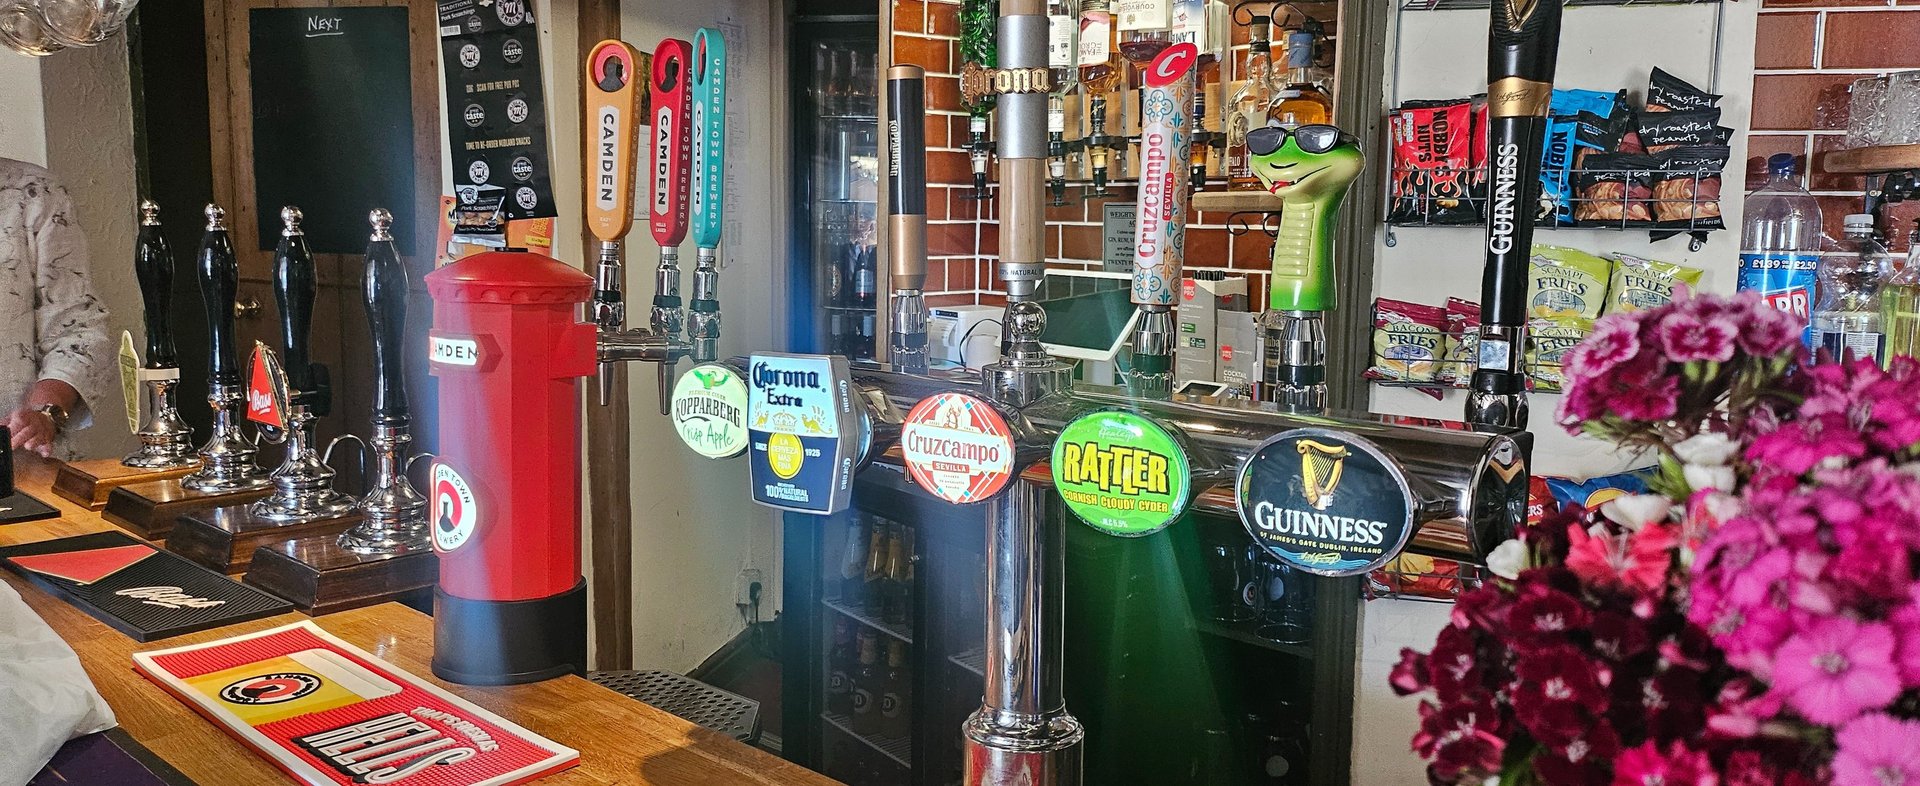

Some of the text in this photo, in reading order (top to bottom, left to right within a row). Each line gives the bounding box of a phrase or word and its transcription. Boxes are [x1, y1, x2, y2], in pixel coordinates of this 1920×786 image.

[308, 15, 342, 31] NEXT
[960, 61, 1051, 105] Corona
[1666, 92, 1712, 107] roasted
[466, 112, 484, 120] taste
[711, 121, 720, 157] TOWN
[1638, 122, 1712, 136] dry roasted
[1653, 134, 1700, 145] peanuts
[681, 127, 690, 161] TOWN
[1417, 124, 1432, 163] NUTS
[513, 165, 532, 173] taste
[601, 113, 615, 201] CAMDEN
[658, 114, 669, 205] CAMDEN
[679, 168, 687, 227] BREWERY
[709, 165, 718, 228] BREWERY
[1138, 133, 1166, 258] Cruzcampo
[1164, 177, 1173, 217] SEVILLA
[1489, 142, 1519, 256] GUINNESS
[1541, 267, 1583, 280] SCAMPI
[1629, 267, 1673, 283] SCAMPI
[1794, 261, 1817, 270] £2.50
[1537, 277, 1588, 296] FRIES
[1625, 275, 1675, 297] FRIES
[1392, 324, 1434, 333] BACON
[1388, 334, 1438, 349] FRIES
[752, 361, 820, 392] Corona
[252, 390, 272, 411] Bass
[766, 388, 803, 407] Extra
[675, 396, 741, 428] KOPPARBERG
[706, 423, 734, 450] Apple
[908, 429, 1000, 465] Cruzcampo
[935, 463, 966, 472] SEVILLA
[1063, 441, 1170, 495] RATTLER
[451, 474, 471, 504] TOWN
[1063, 489, 1168, 513] CORNISH CLOUDY CYDER
[1254, 501, 1388, 545] GUINNESS
[1298, 539, 1317, 547] GATE
[1319, 541, 1349, 552] DUBLIN,
[1350, 545, 1382, 555] IRELAND
